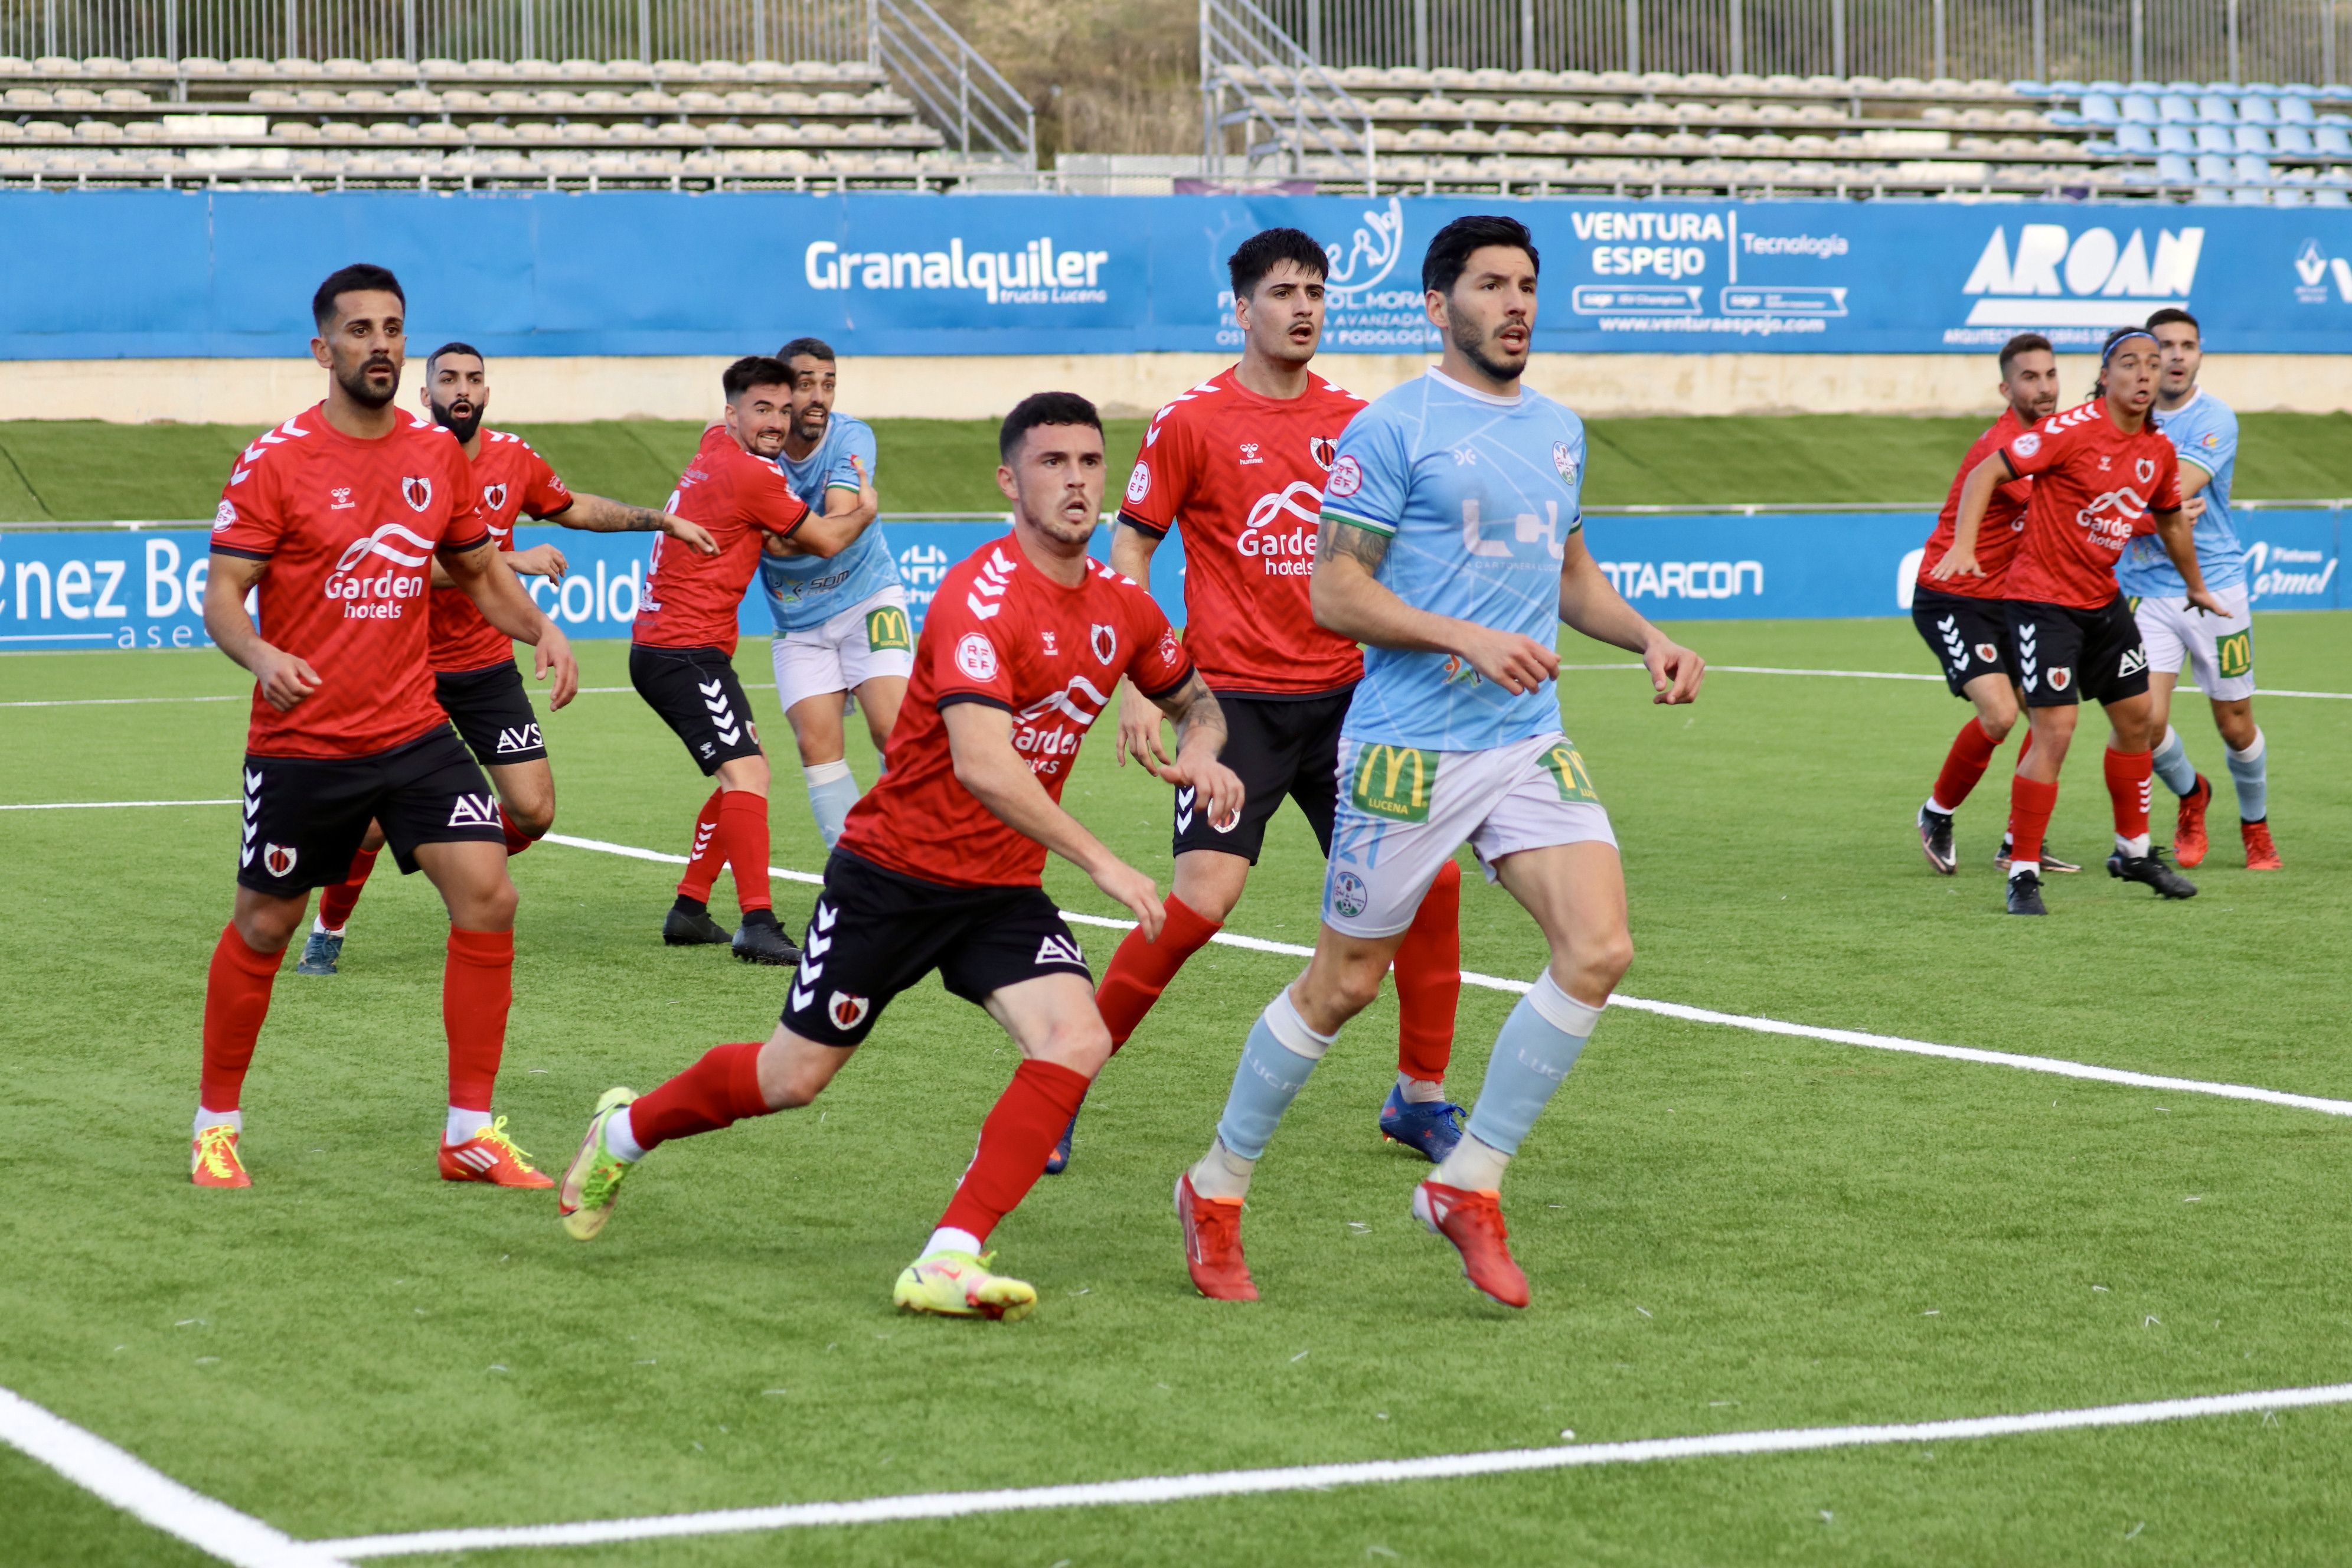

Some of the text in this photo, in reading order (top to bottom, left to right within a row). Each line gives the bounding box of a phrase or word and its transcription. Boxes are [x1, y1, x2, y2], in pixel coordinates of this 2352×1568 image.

[1571, 211, 1724, 241] VENTURA
[805, 237, 1109, 304] Granalquiler
[1592, 246, 1706, 280] ESPEJO
[1962, 224, 2206, 296] AROAN
[1000, 289, 1107, 303] trucks Lucena
[1335, 313, 1427, 328] AVANZADA
[1599, 316, 1825, 337] www.venturaespejo.com
[1239, 456, 1263, 465] hummel
[2076, 508, 2134, 538] Garde
[1237, 527, 1318, 557] Garde
[145, 538, 210, 618] Be
[325, 569, 423, 599] Garden
[518, 559, 641, 624] cold
[344, 600, 402, 619] hotels
[496, 723, 543, 753] AVS
[1368, 798, 1409, 815] LUCENA
[1035, 935, 1083, 964] AV
